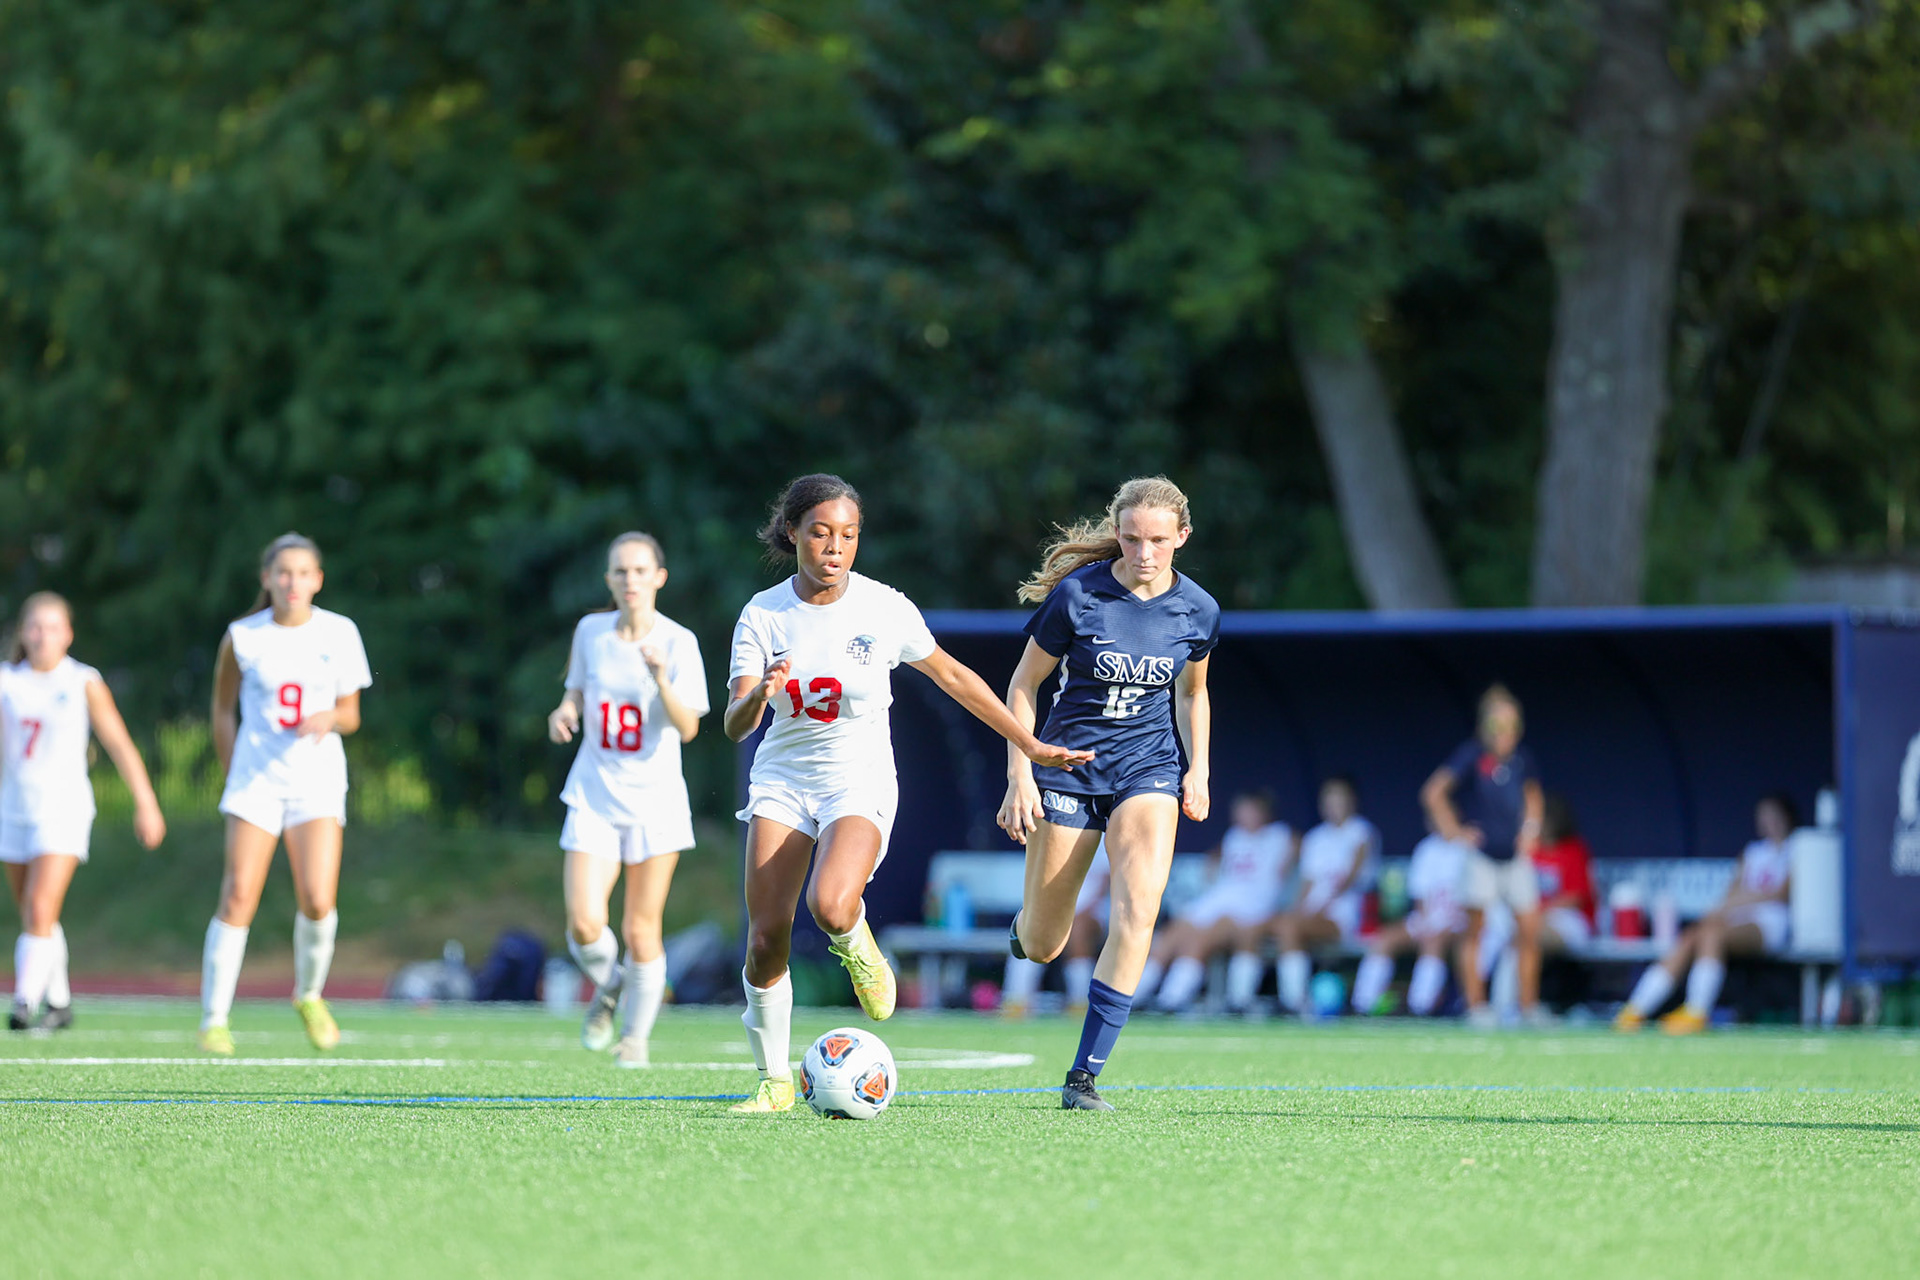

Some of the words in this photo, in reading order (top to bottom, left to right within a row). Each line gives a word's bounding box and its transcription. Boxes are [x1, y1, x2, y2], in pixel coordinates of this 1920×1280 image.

[1094, 651, 1174, 686] SMS
[278, 684, 302, 728] 9
[785, 677, 842, 723] 13
[1102, 685, 1146, 719] 12
[21, 717, 41, 759] 7
[600, 702, 642, 751] 18
[1043, 790, 1078, 814] SMS
